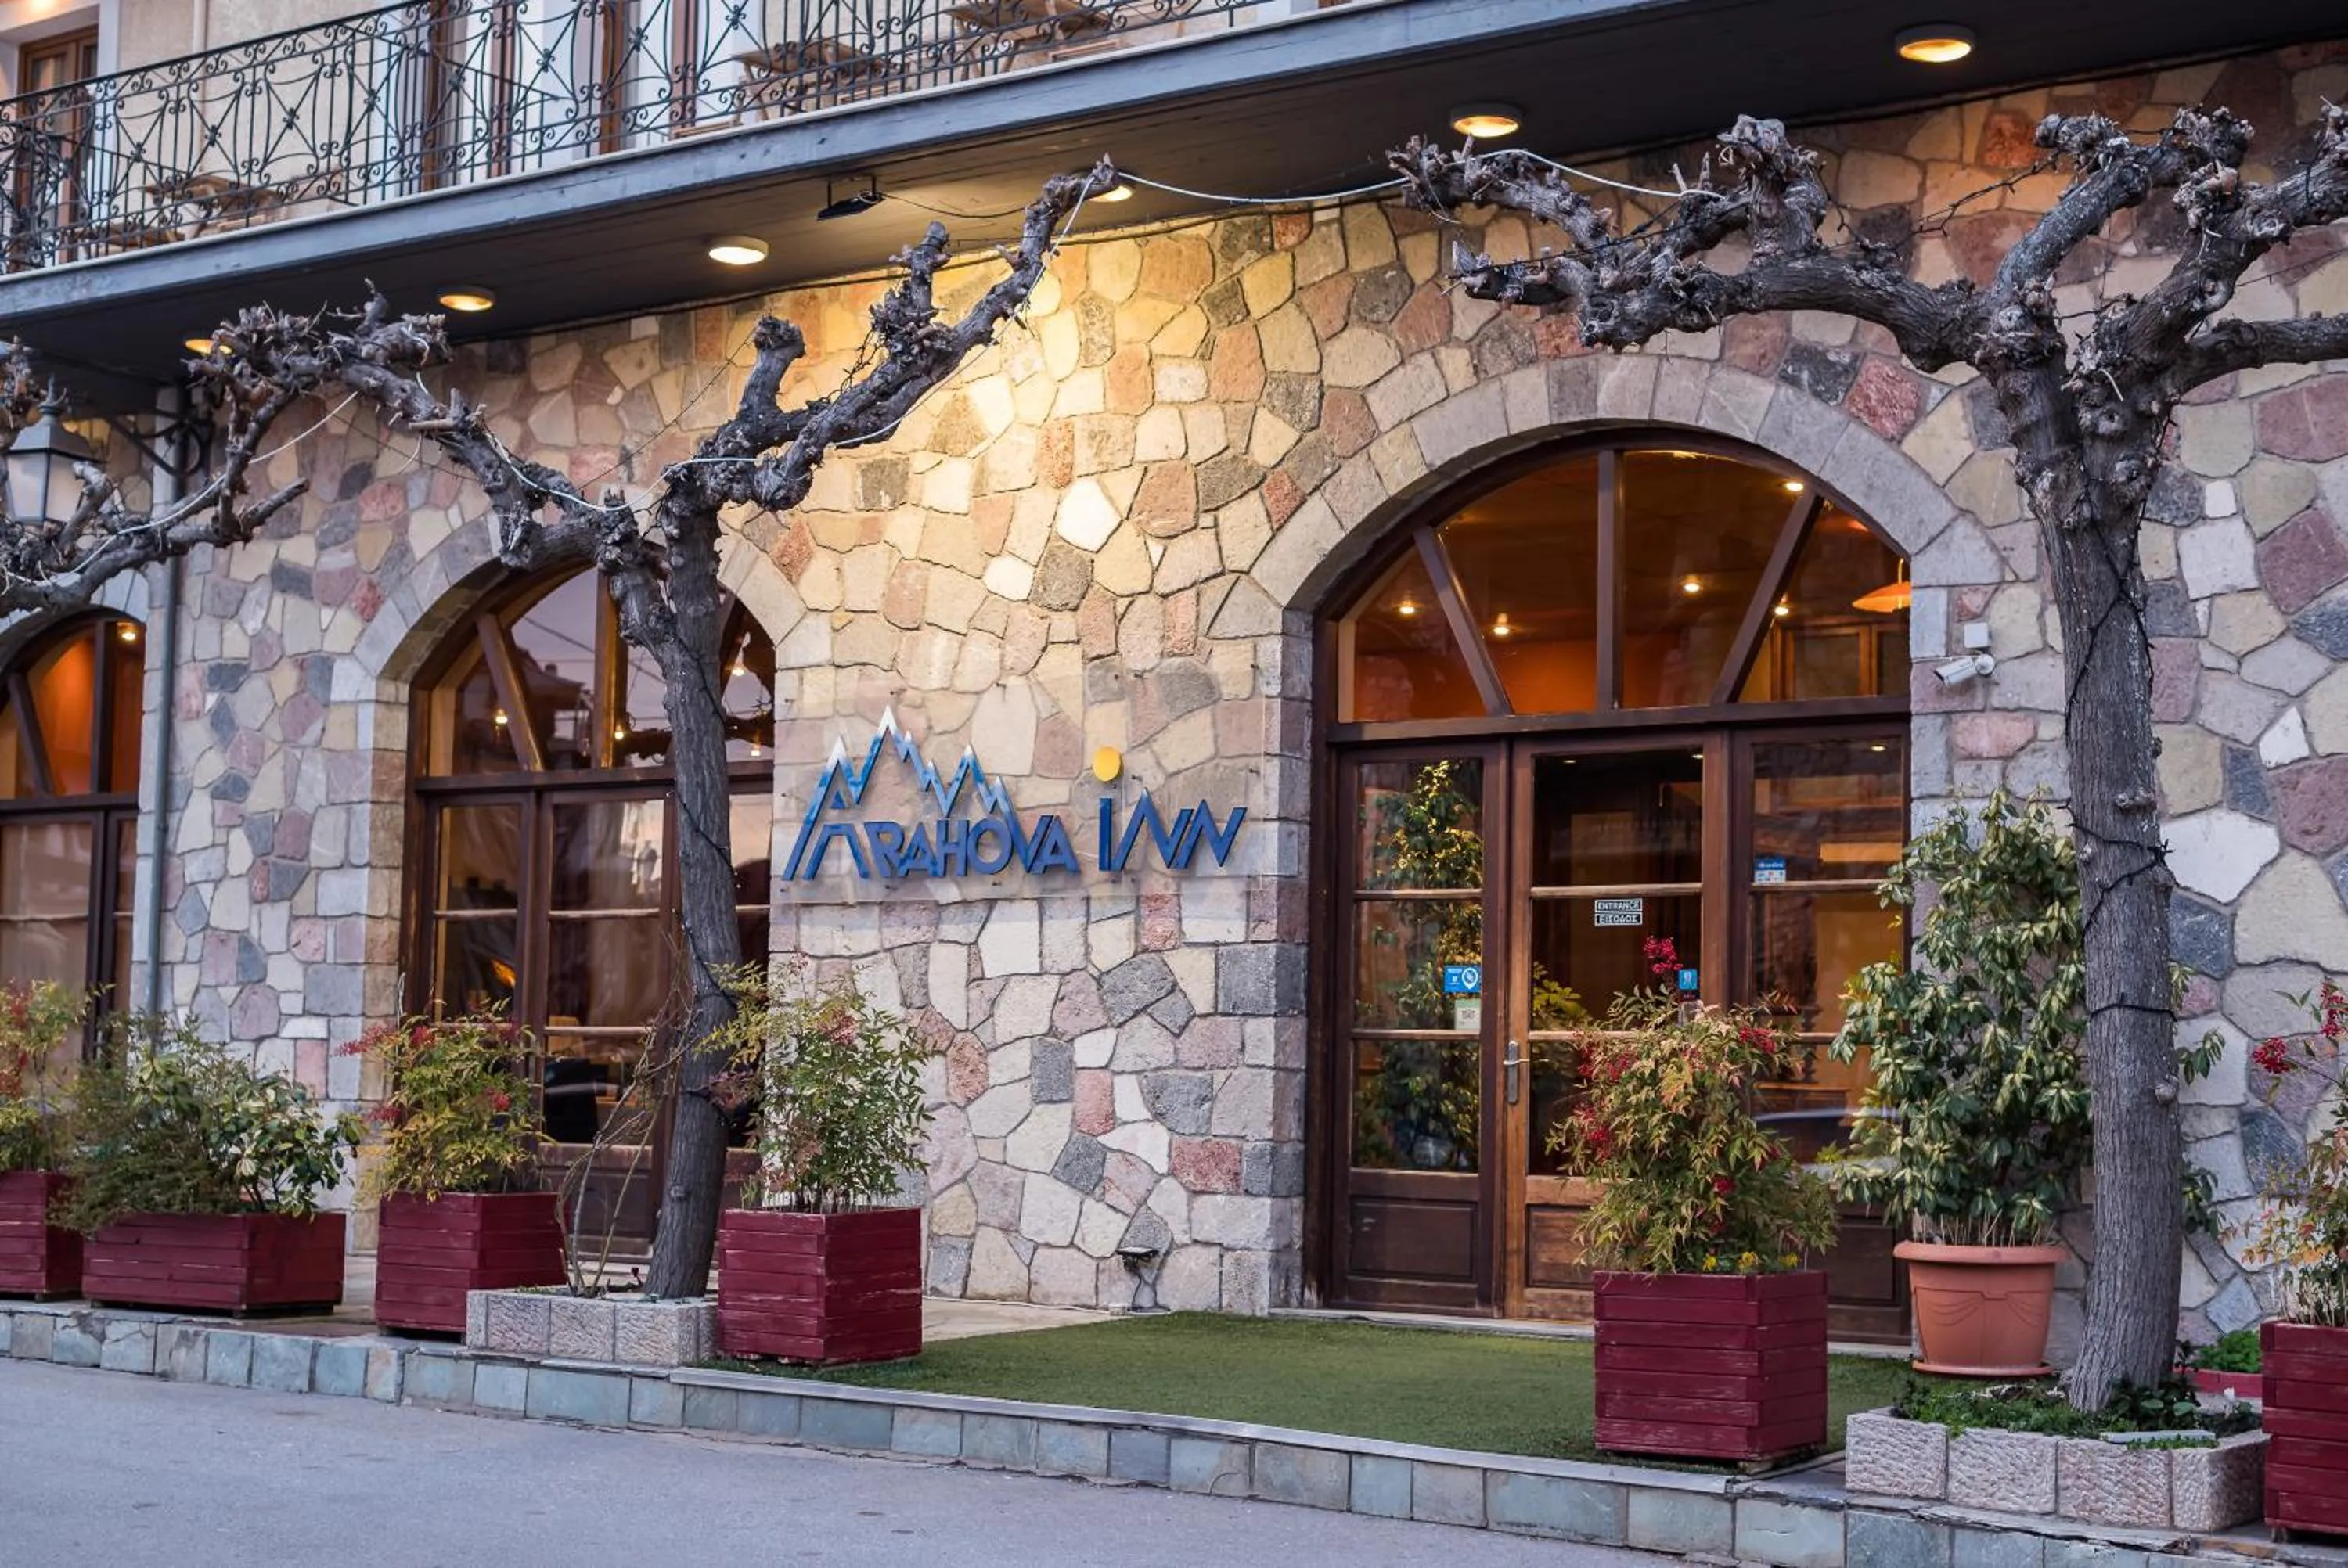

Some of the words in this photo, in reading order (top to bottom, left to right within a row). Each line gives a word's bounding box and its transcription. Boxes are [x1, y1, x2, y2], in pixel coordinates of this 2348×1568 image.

[783, 734, 1082, 881] ARAHOVA
[1099, 787, 1247, 872] INN
[1597, 901, 1640, 911] ENTRANCE
